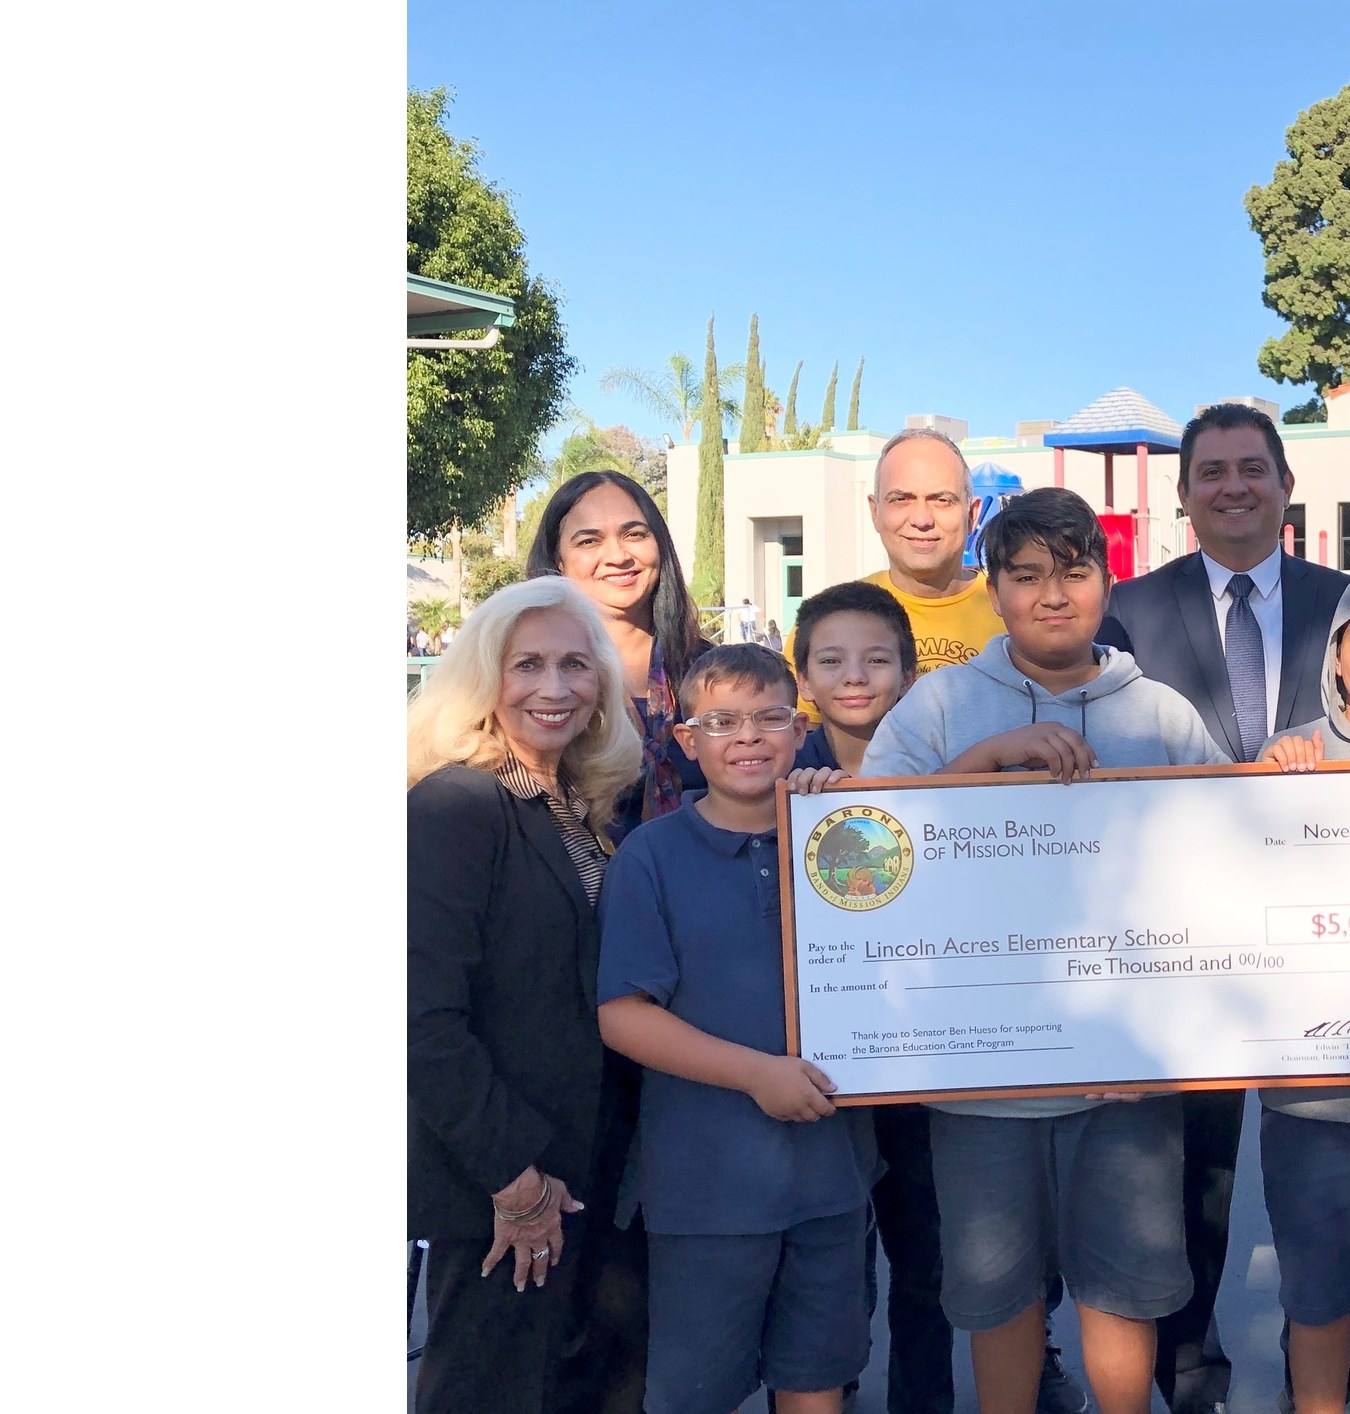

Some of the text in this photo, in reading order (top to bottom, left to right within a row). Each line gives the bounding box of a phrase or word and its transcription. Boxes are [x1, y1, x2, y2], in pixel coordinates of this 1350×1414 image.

[812, 808, 905, 842] BARONA
[1265, 837, 1287, 846] Date
[808, 942, 855, 954] Pay to the
[865, 927, 1189, 959] Lincoln Acres Elementary School
[808, 954, 847, 964] order of
[1067, 952, 1285, 976] Five Thousand and 00/100
[809, 980, 889, 993] In the amount of
[851, 1022, 1063, 1041] Thank you to Senator Ben Hueso for supporting
[852, 1039, 1014, 1055] the Barona Education Grant Program
[812, 1052, 847, 1061] Memo:
